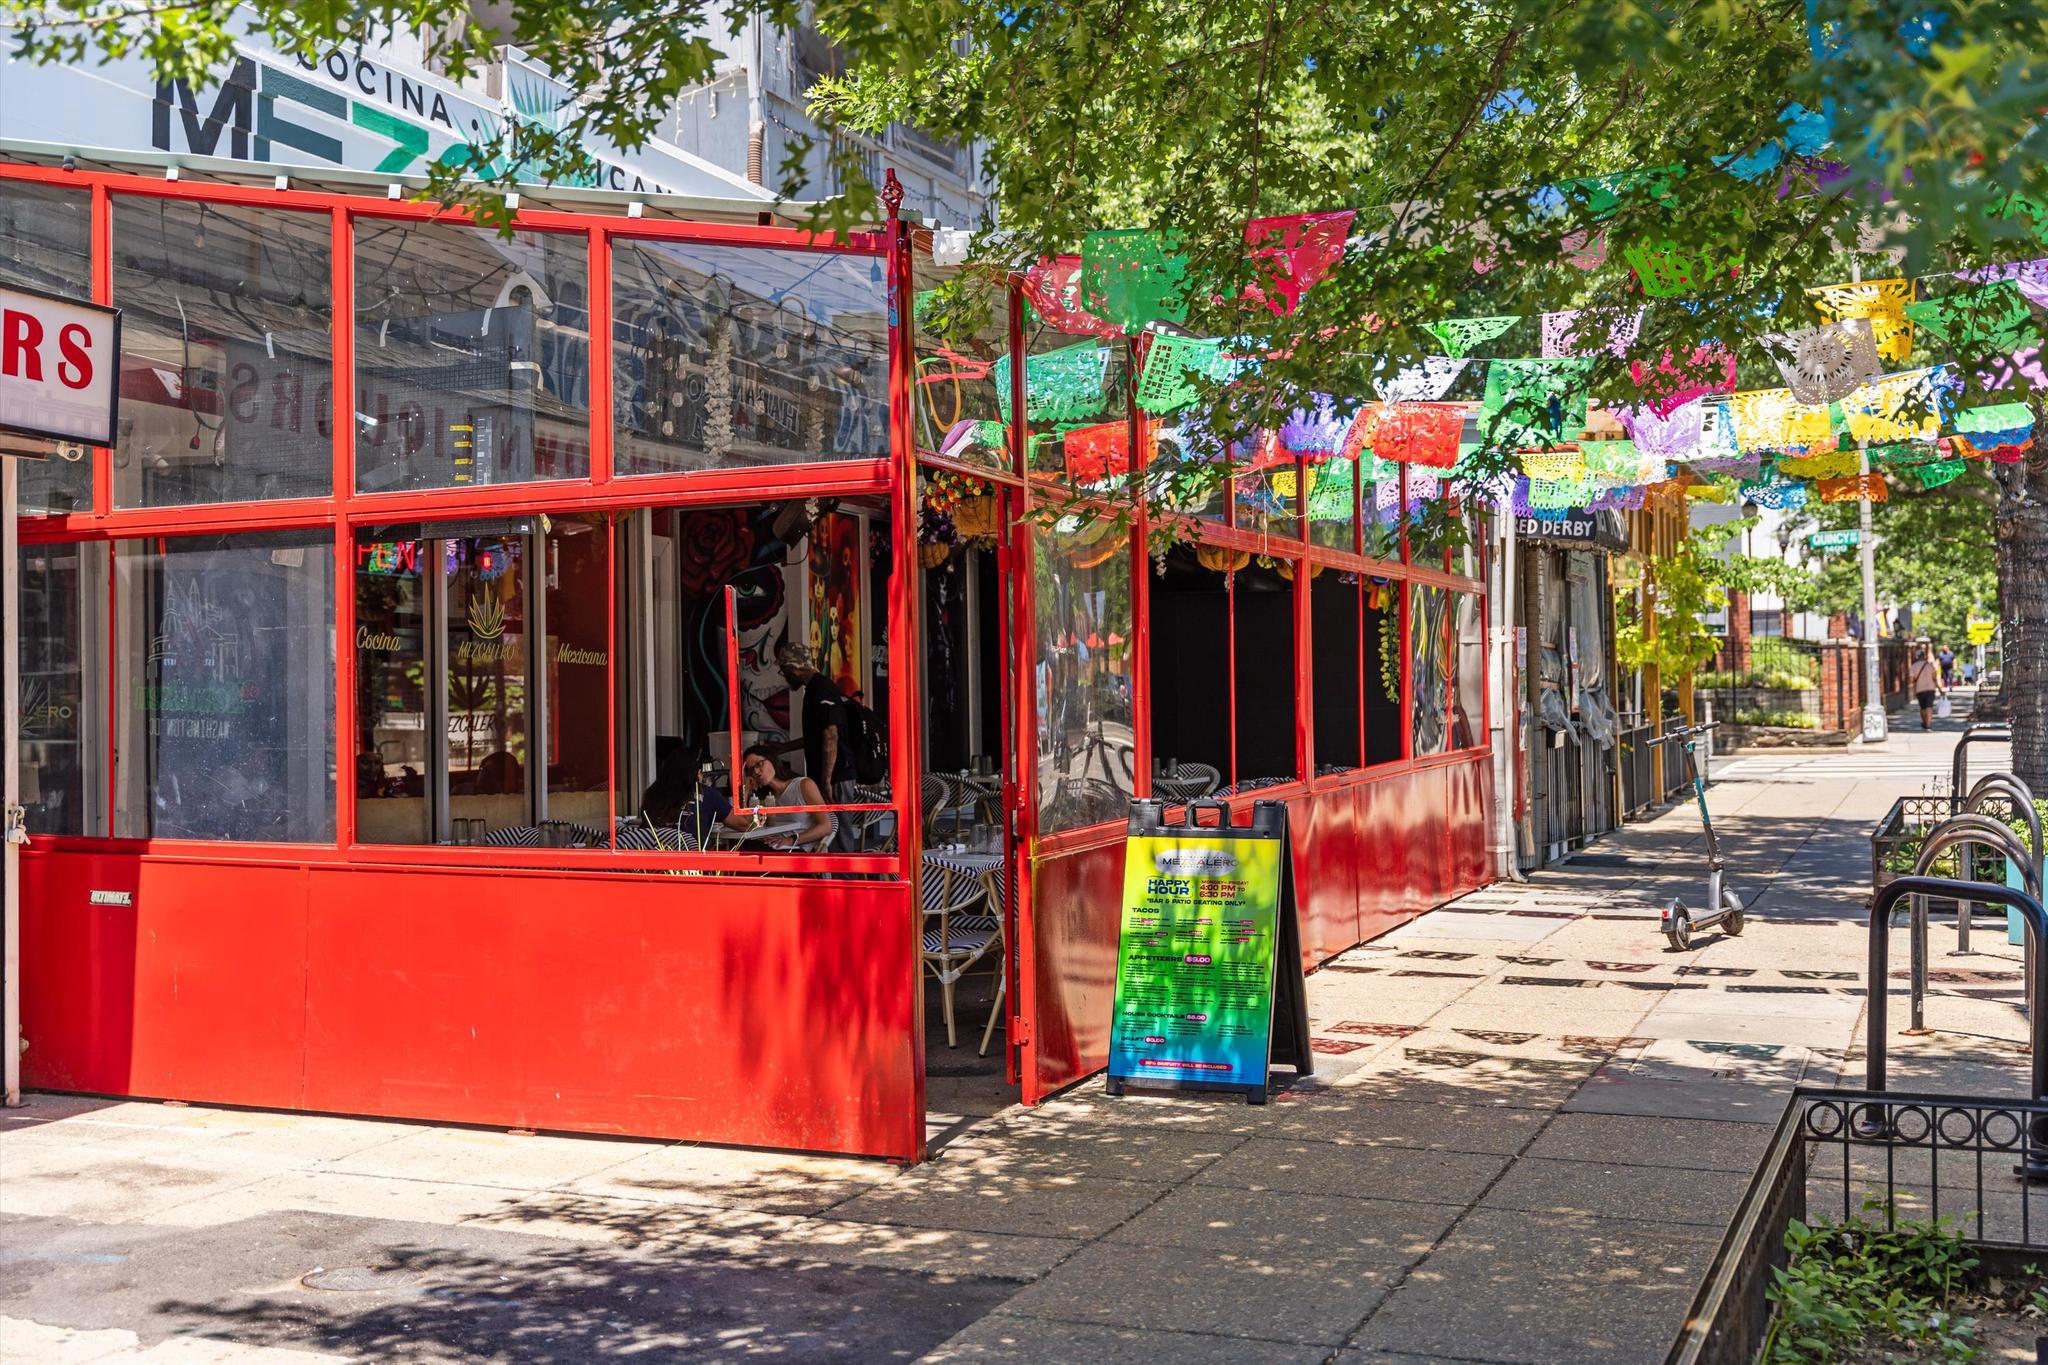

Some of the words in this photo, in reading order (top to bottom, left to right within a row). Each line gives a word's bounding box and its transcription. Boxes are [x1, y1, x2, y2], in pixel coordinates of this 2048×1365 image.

[1542, 520, 1594, 537] DERBY
[1812, 532, 1849, 545] QUINCY
[356, 625, 401, 651] Cocina
[458, 641, 517, 661] MEZCALERO
[557, 643, 609, 666] Mexicana
[1162, 857, 1239, 867] MEZCALERO
[1148, 879, 1190, 887] HAPPY
[1147, 886, 1190, 895] HOUR
[1128, 954, 1183, 963] APPETIZERS
